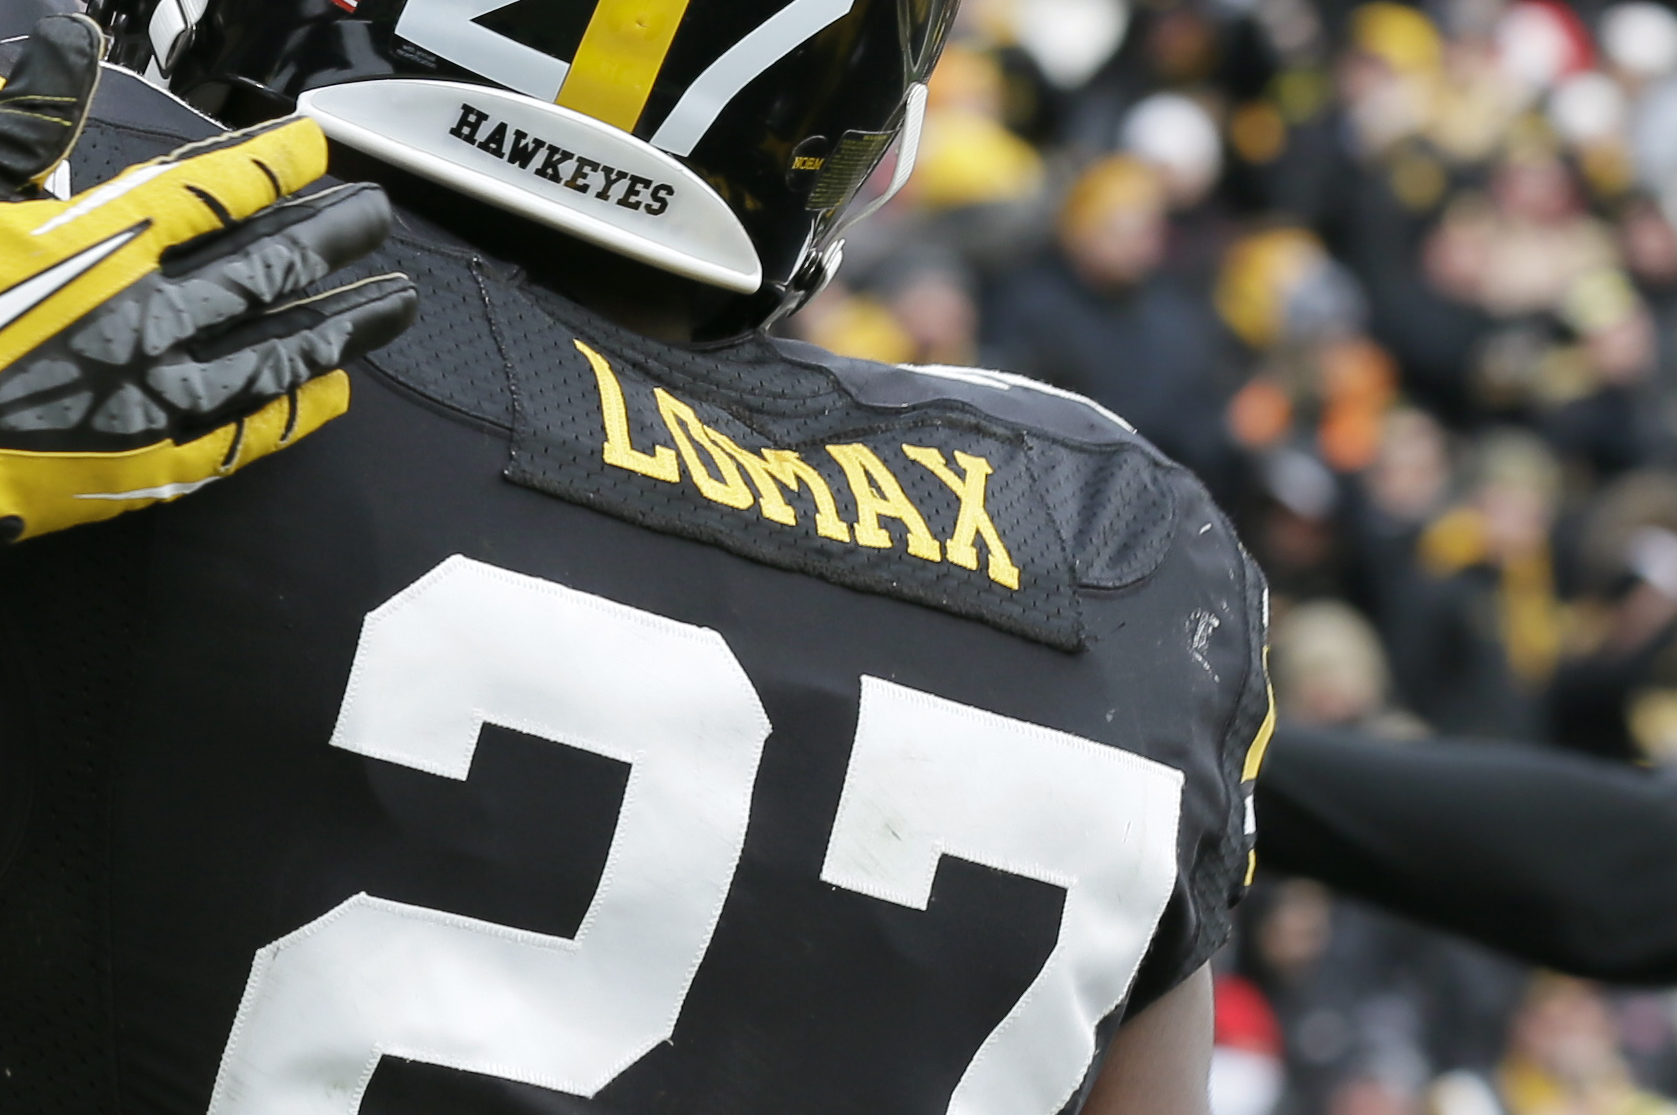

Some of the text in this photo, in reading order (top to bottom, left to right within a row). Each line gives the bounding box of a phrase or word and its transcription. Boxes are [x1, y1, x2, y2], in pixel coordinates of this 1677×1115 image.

[449, 103, 675, 218] HAWKEYES
[573, 338, 1020, 589] LOMAX
[207, 554, 1185, 1115] 27
